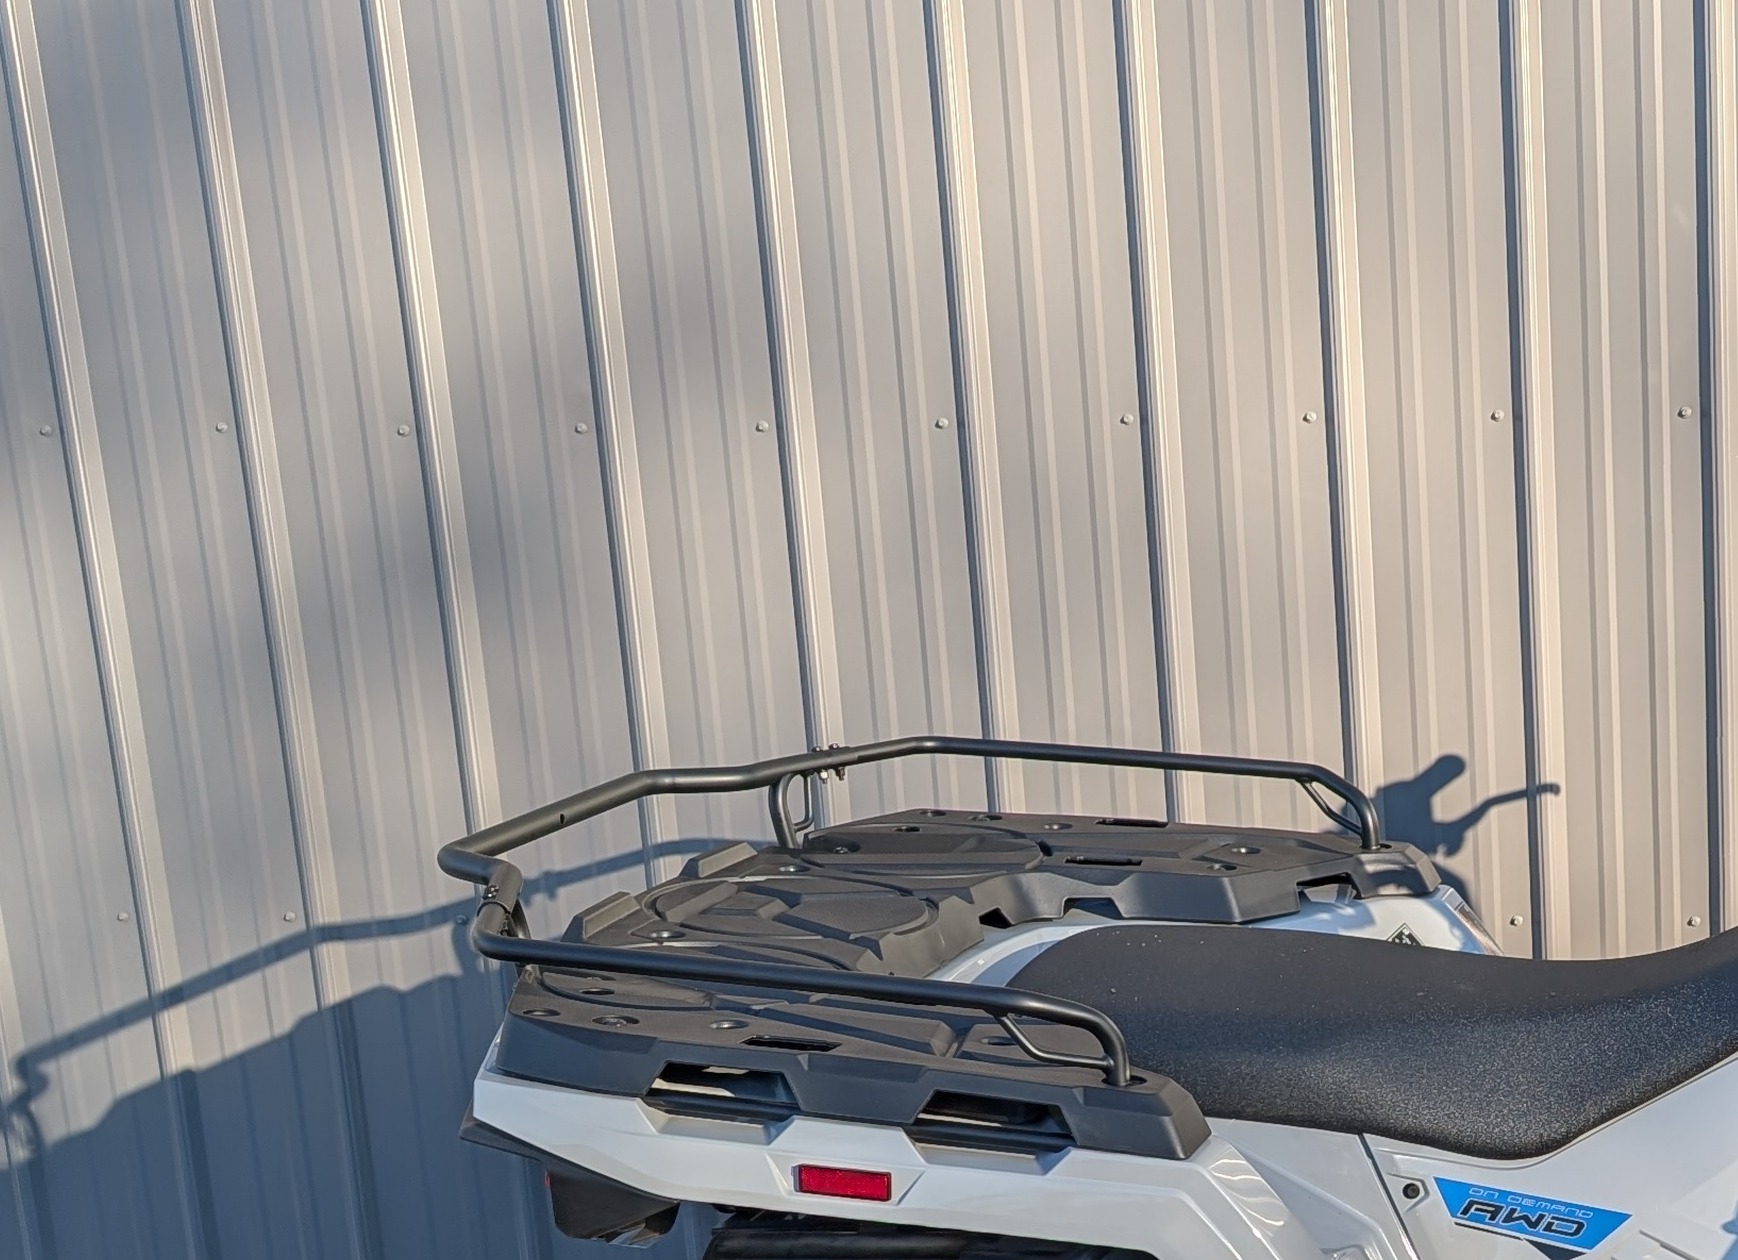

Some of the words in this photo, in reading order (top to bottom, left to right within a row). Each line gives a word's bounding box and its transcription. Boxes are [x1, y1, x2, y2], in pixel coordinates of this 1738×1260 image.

[1458, 1198, 1588, 1239] AWD
[1468, 1187, 1499, 1200] ON
[1506, 1195, 1594, 1219] DEMAND
